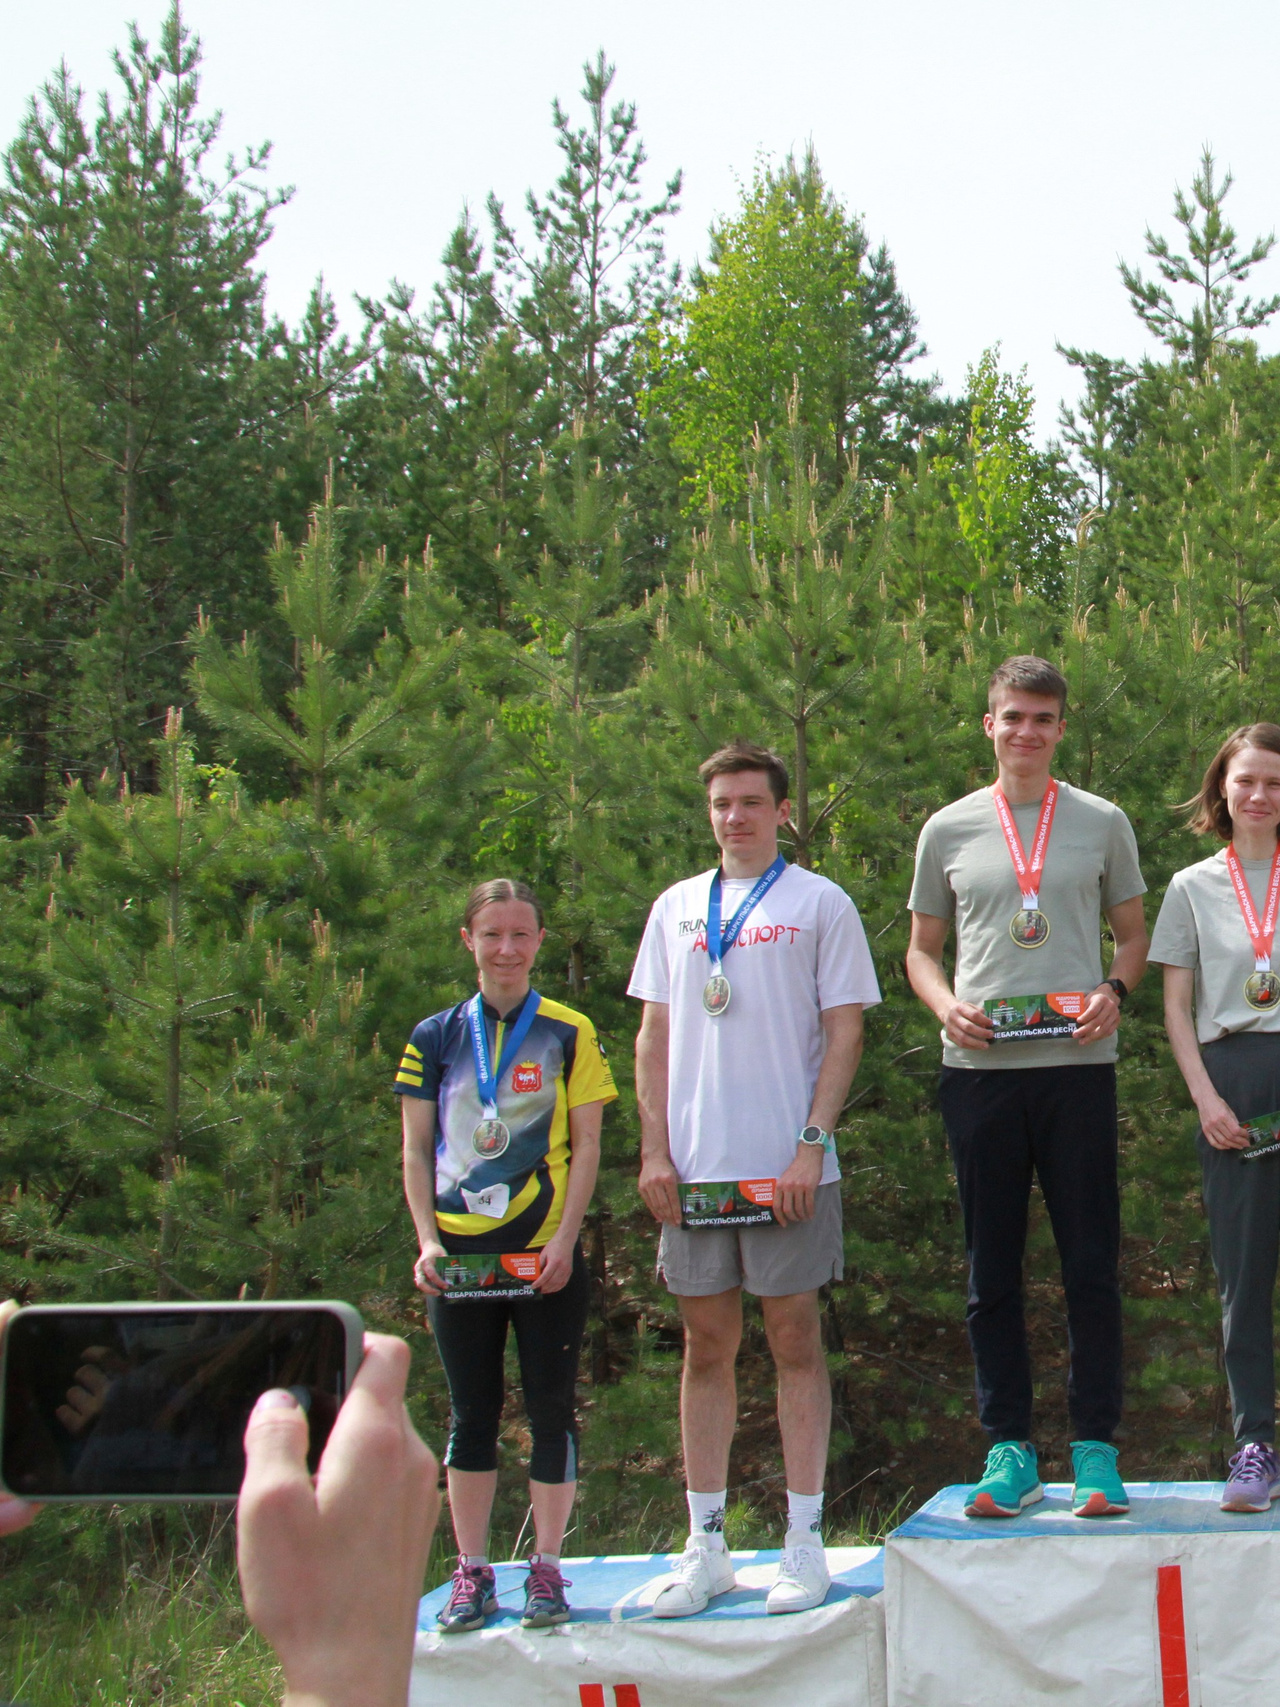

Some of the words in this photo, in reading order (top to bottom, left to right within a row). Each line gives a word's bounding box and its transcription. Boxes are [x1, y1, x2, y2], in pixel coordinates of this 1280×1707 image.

[686, 1217, 746, 1226] ЧЕБАРКУЛЬСКАЯ
[746, 1215, 772, 1223] ВЕСНА
[444, 1289, 508, 1299] ЧЕБАРКУЛЬСКАЯ
[508, 1288, 534, 1296] ВЕСНА
